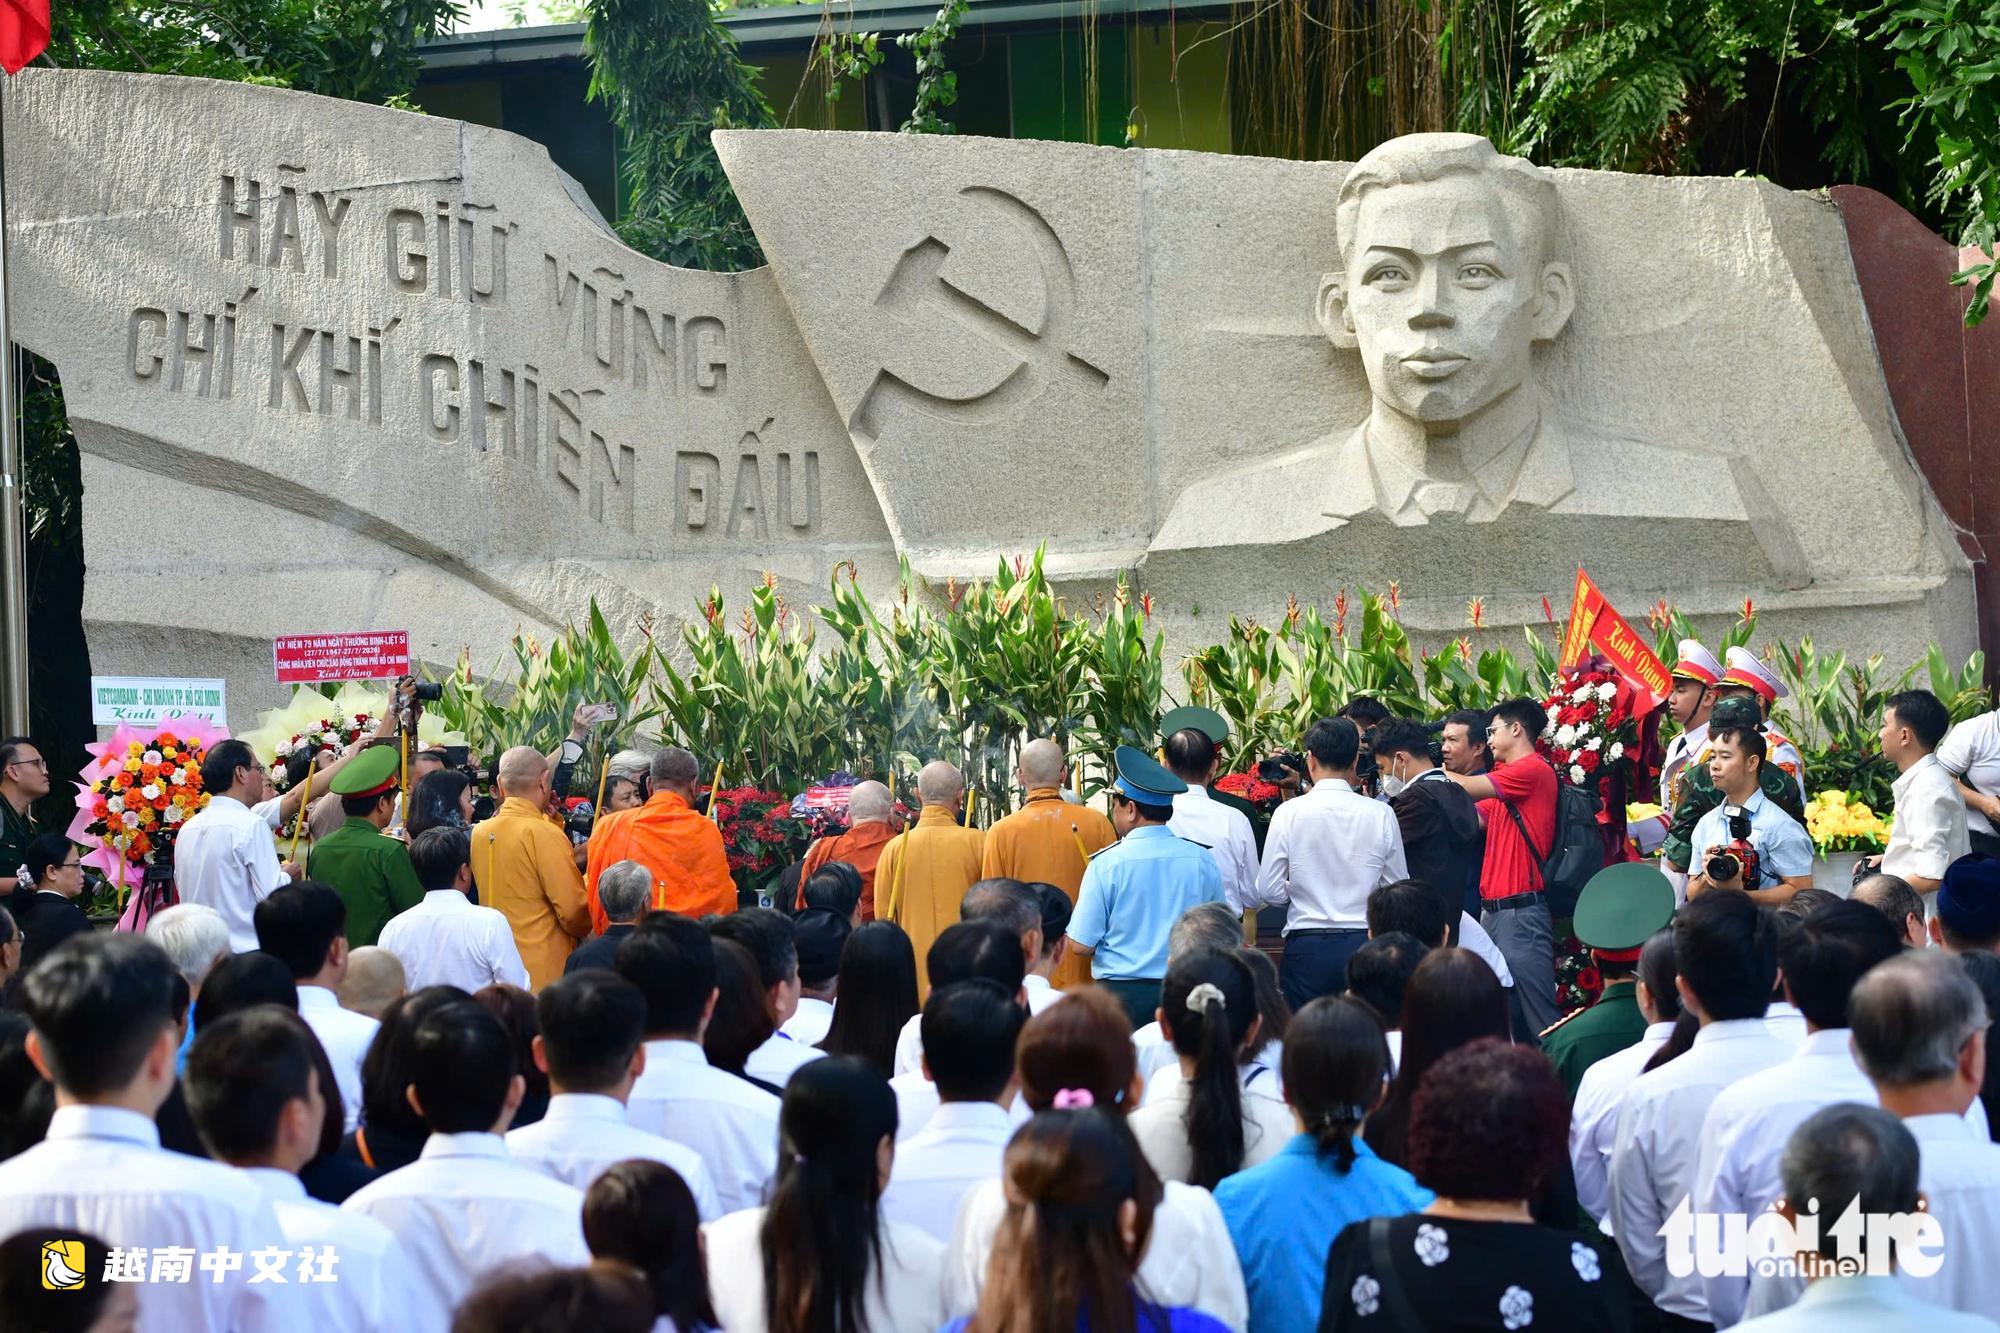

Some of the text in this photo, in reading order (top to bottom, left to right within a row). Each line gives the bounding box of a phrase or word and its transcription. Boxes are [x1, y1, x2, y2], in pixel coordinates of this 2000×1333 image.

[221, 164, 727, 398] HÃY GIỮ VỮNG
[127, 287, 822, 540] CHÍ KHÍ CHIẾN ĐẤU
[1604, 620, 1636, 664] Kính
